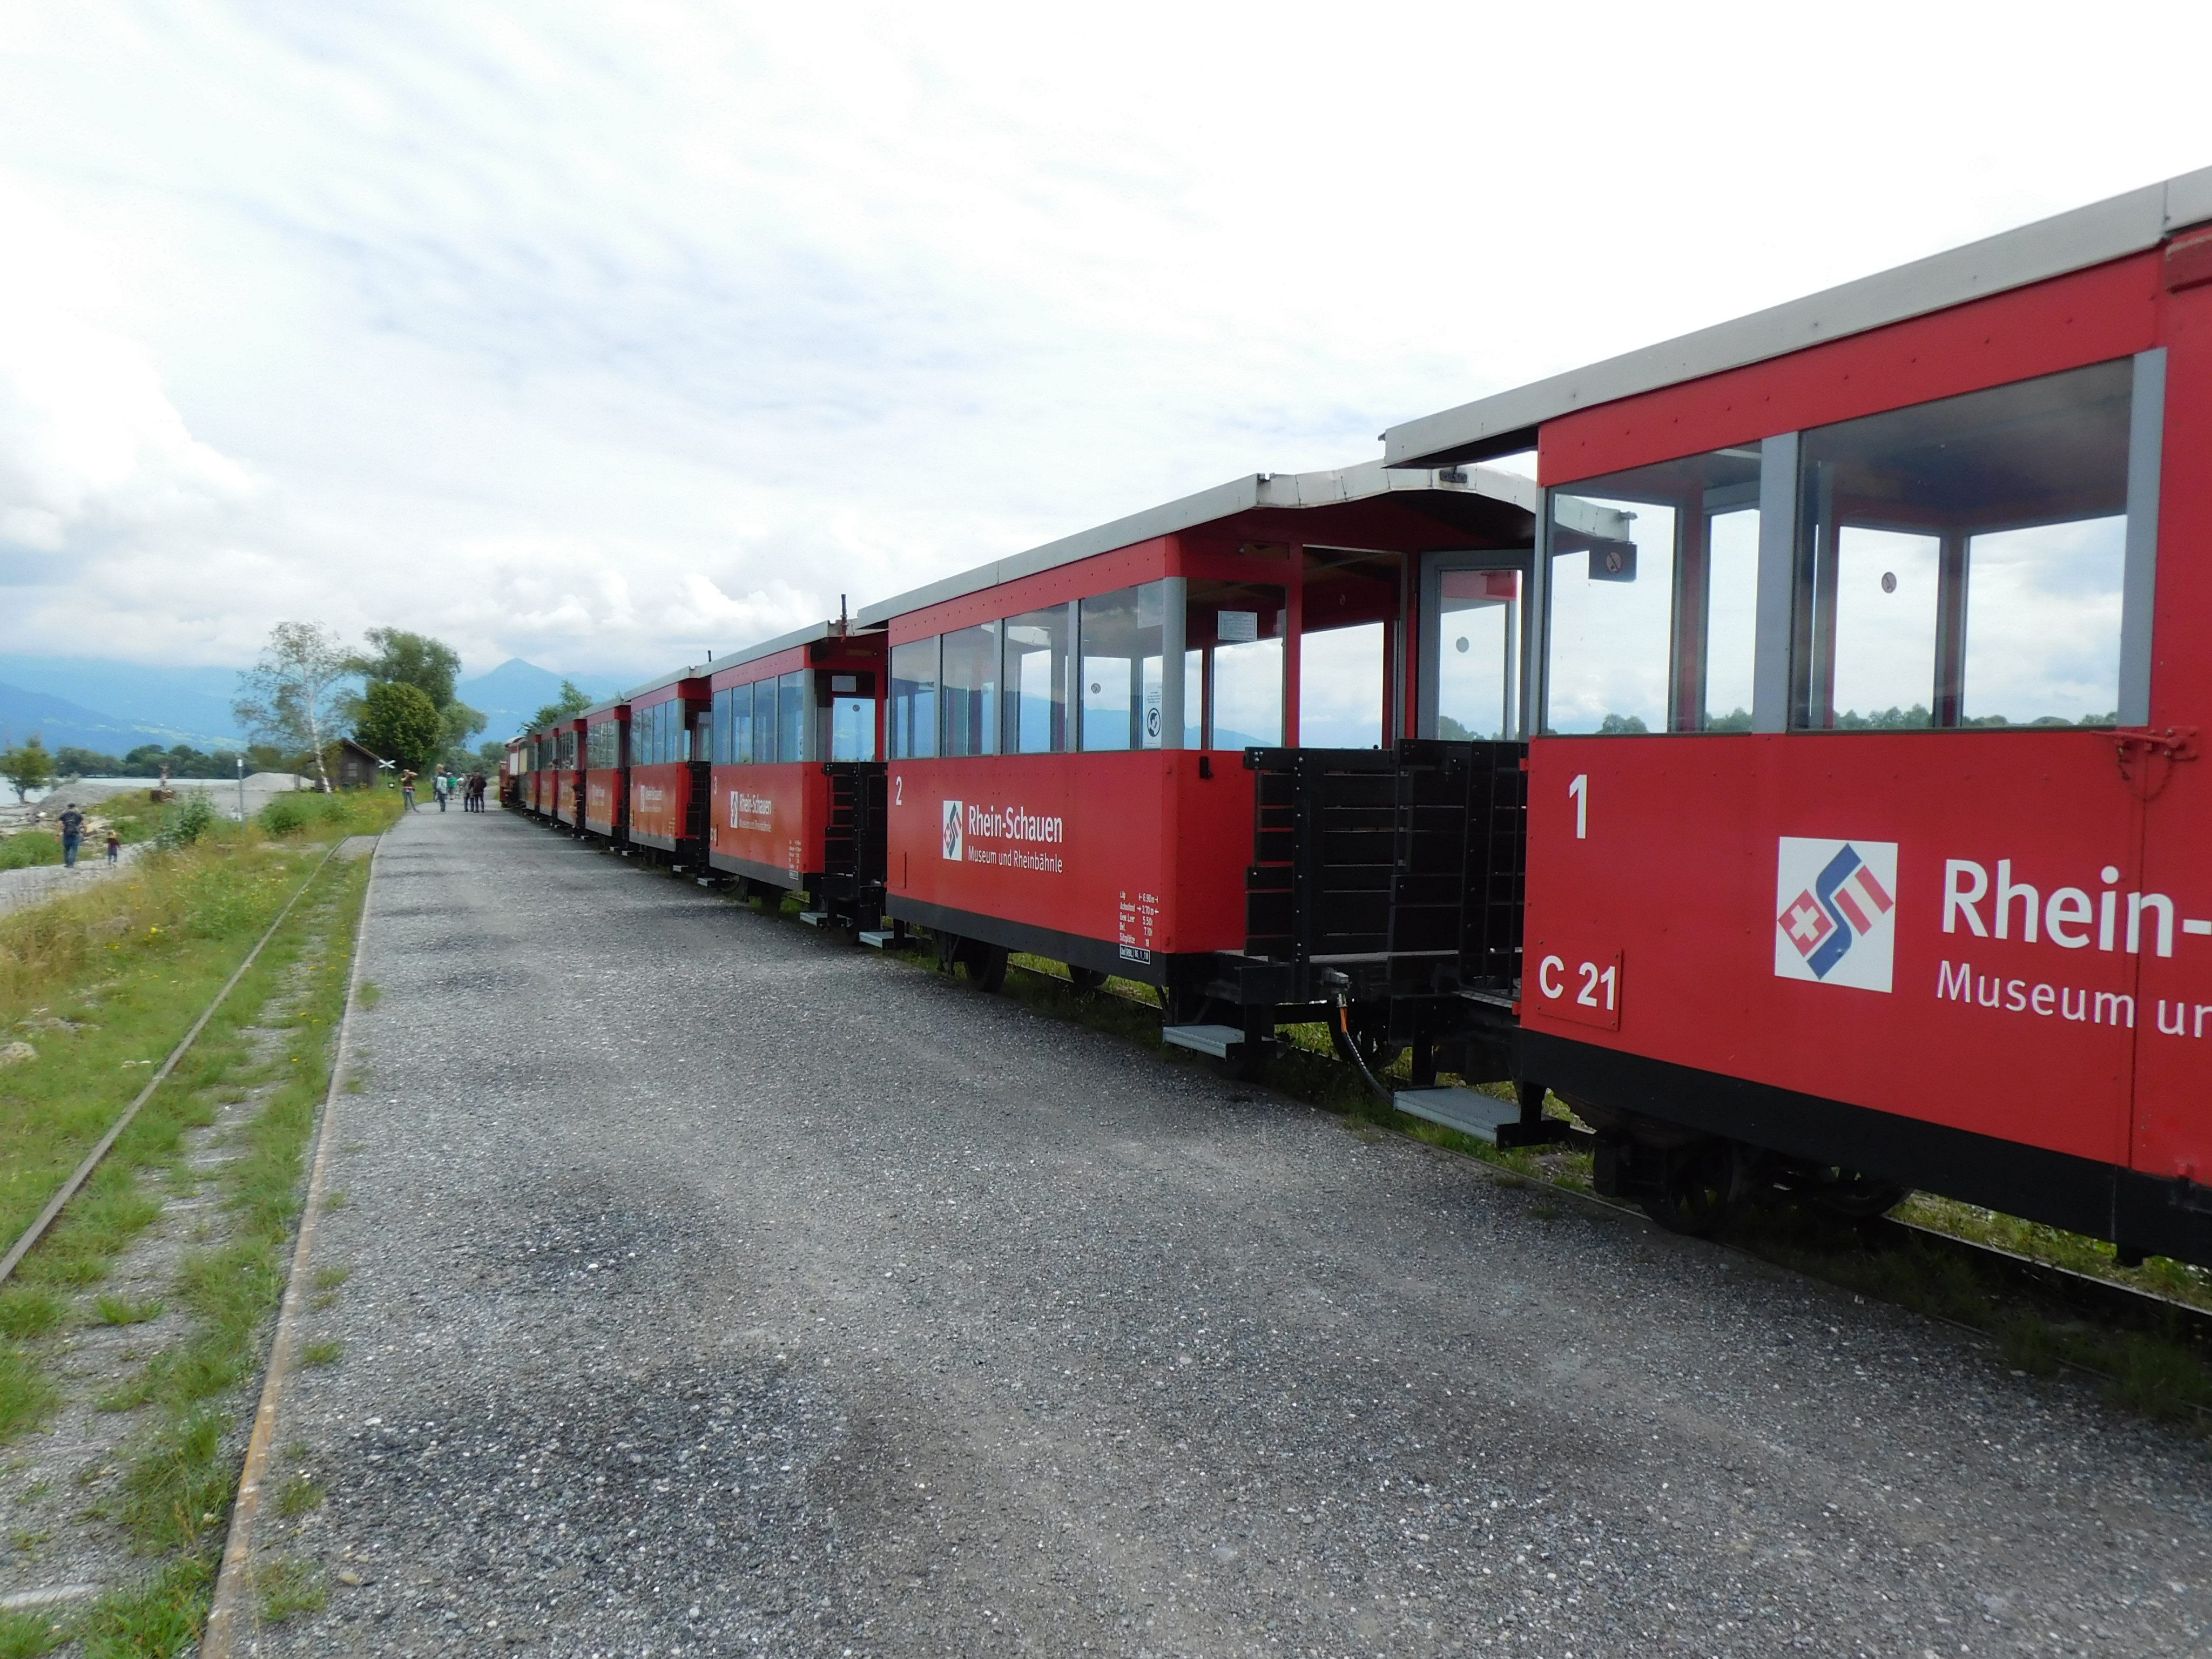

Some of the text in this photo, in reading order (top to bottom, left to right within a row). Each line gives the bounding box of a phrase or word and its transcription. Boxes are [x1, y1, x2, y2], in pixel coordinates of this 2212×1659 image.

[896, 776, 902, 805] 2
[1569, 774, 1587, 839] 1
[968, 805, 1063, 843] Rhein-Schauen
[968, 846, 1063, 873] Museum und Rheinbähnle
[1943, 859, 2212, 958] Rhein-
[1540, 955, 1616, 1010] C 21
[1937, 960, 2134, 1028] Museum
